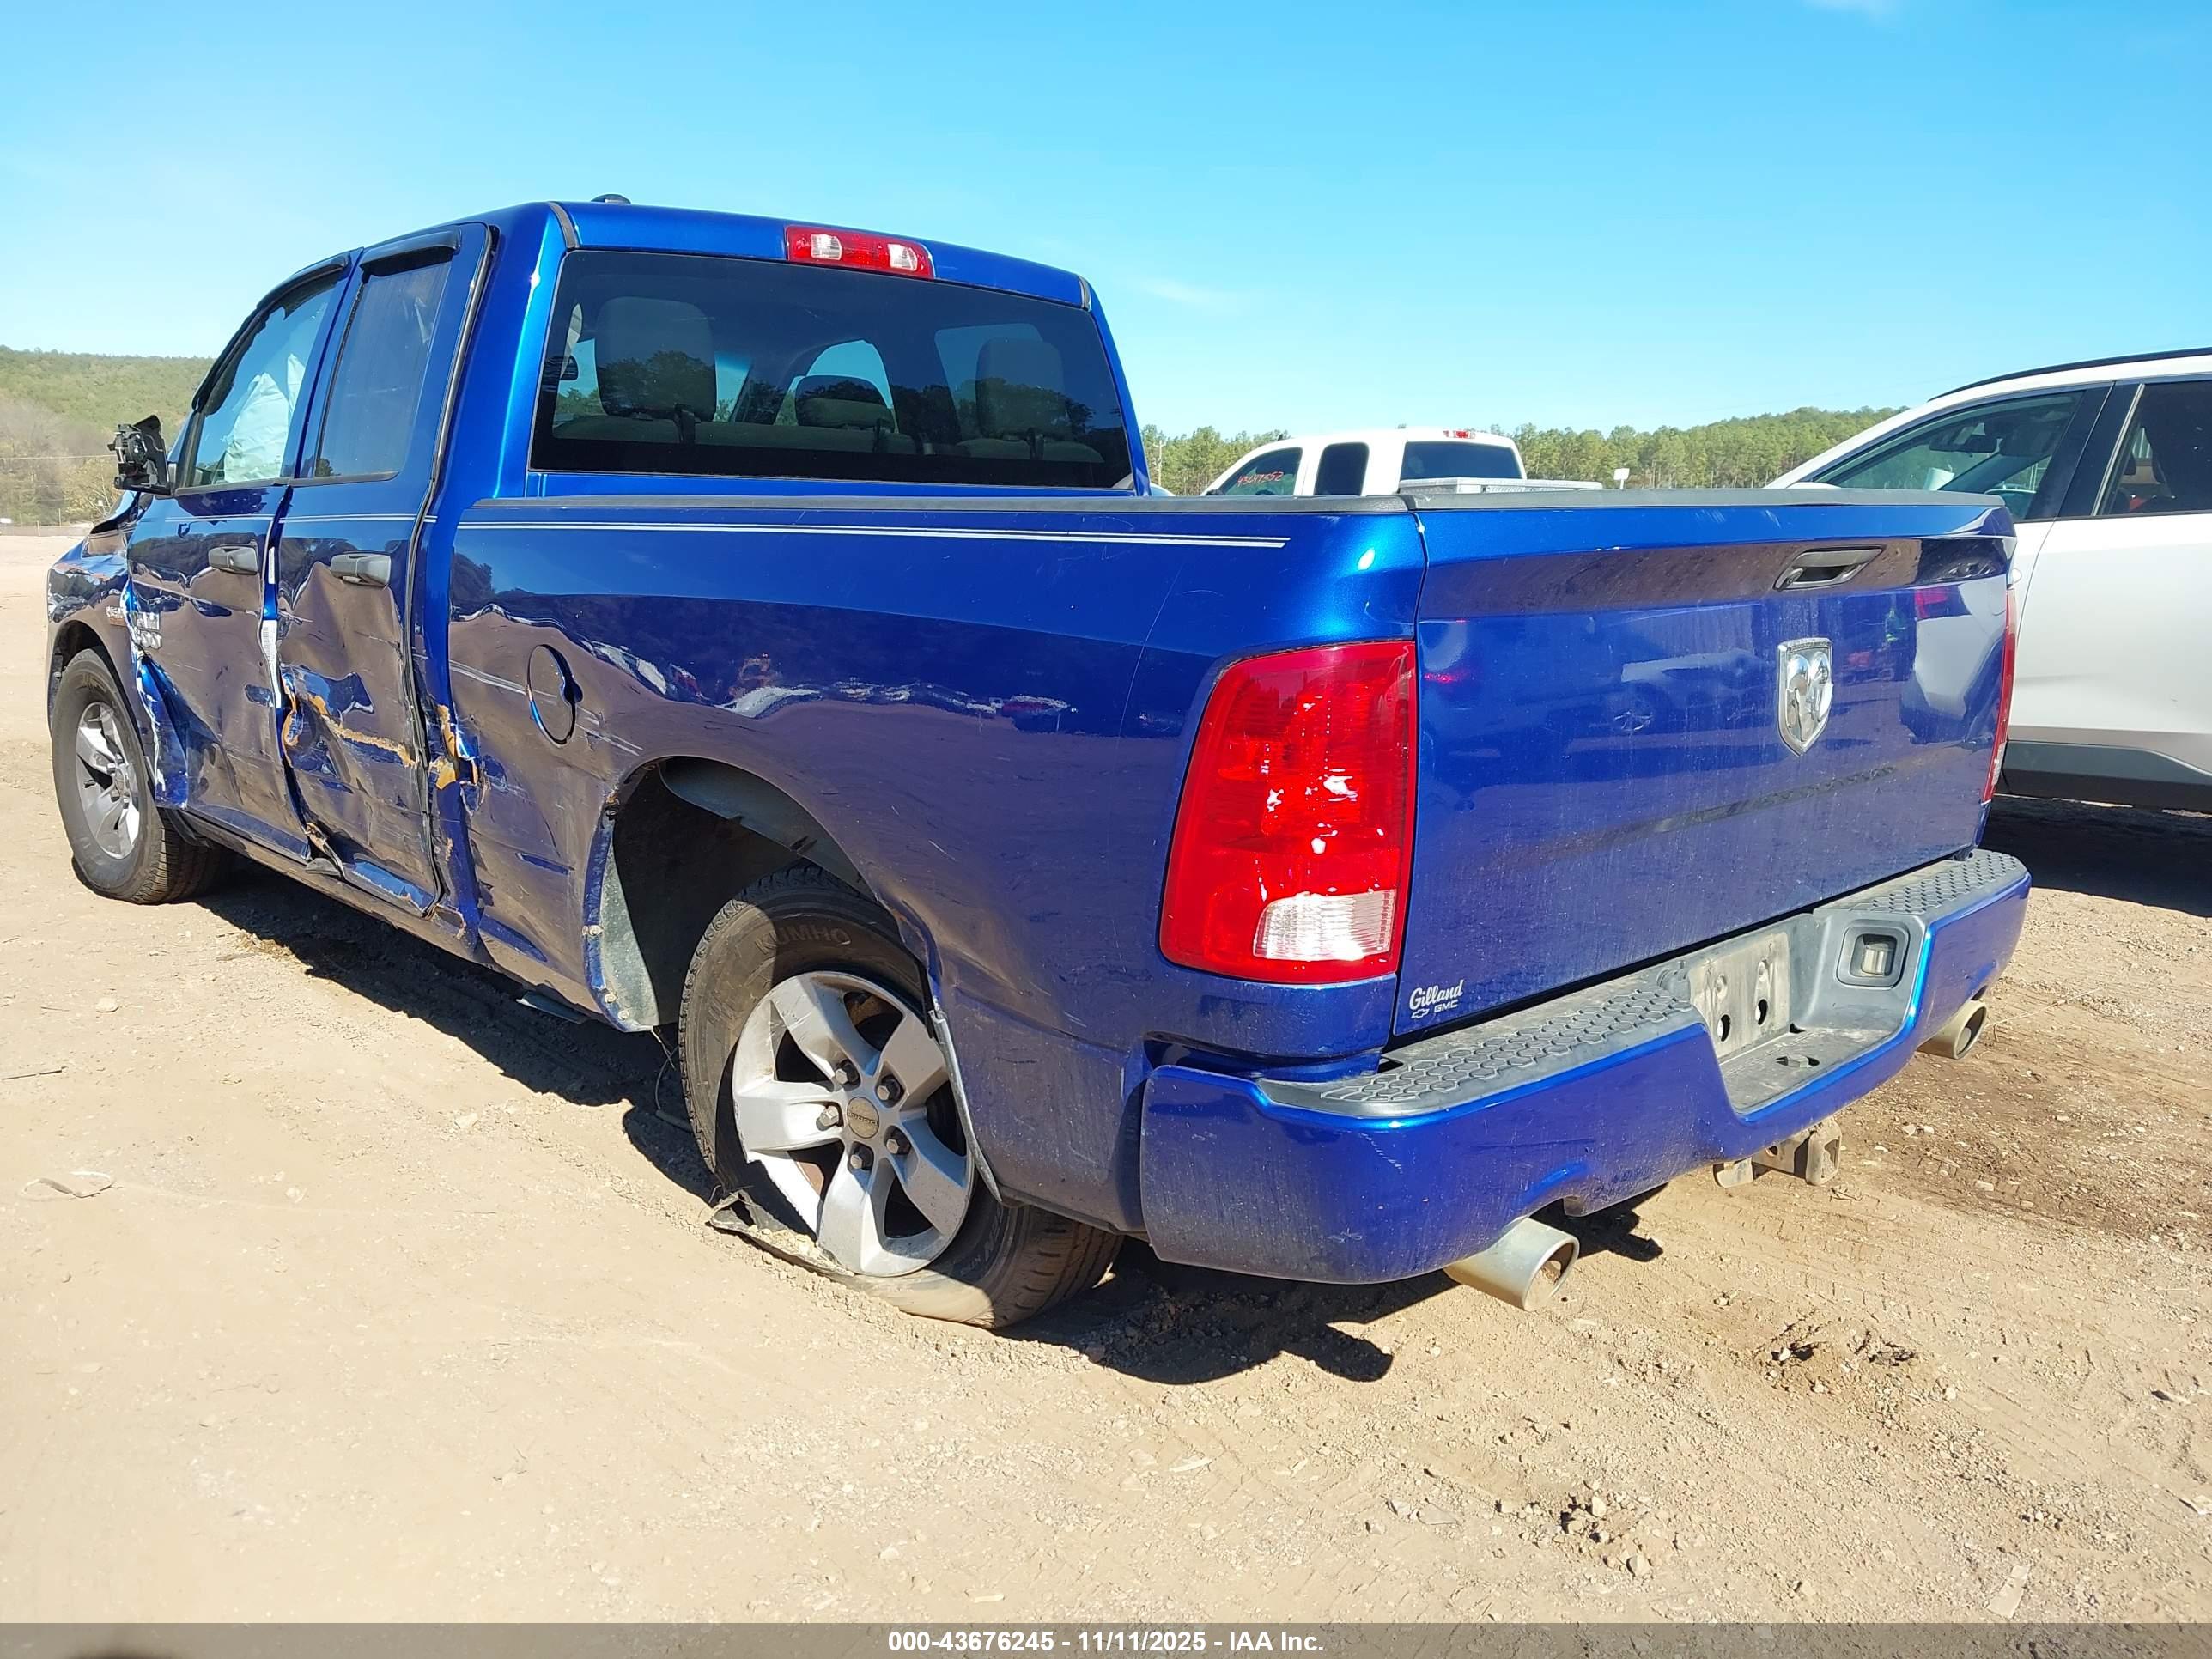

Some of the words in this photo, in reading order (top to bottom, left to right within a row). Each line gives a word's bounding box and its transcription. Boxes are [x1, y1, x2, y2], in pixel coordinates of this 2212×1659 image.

[754, 924, 852, 955] KUMHO
[1409, 979, 1464, 1010] Gilland
[1433, 1000, 1459, 1012] GMC
